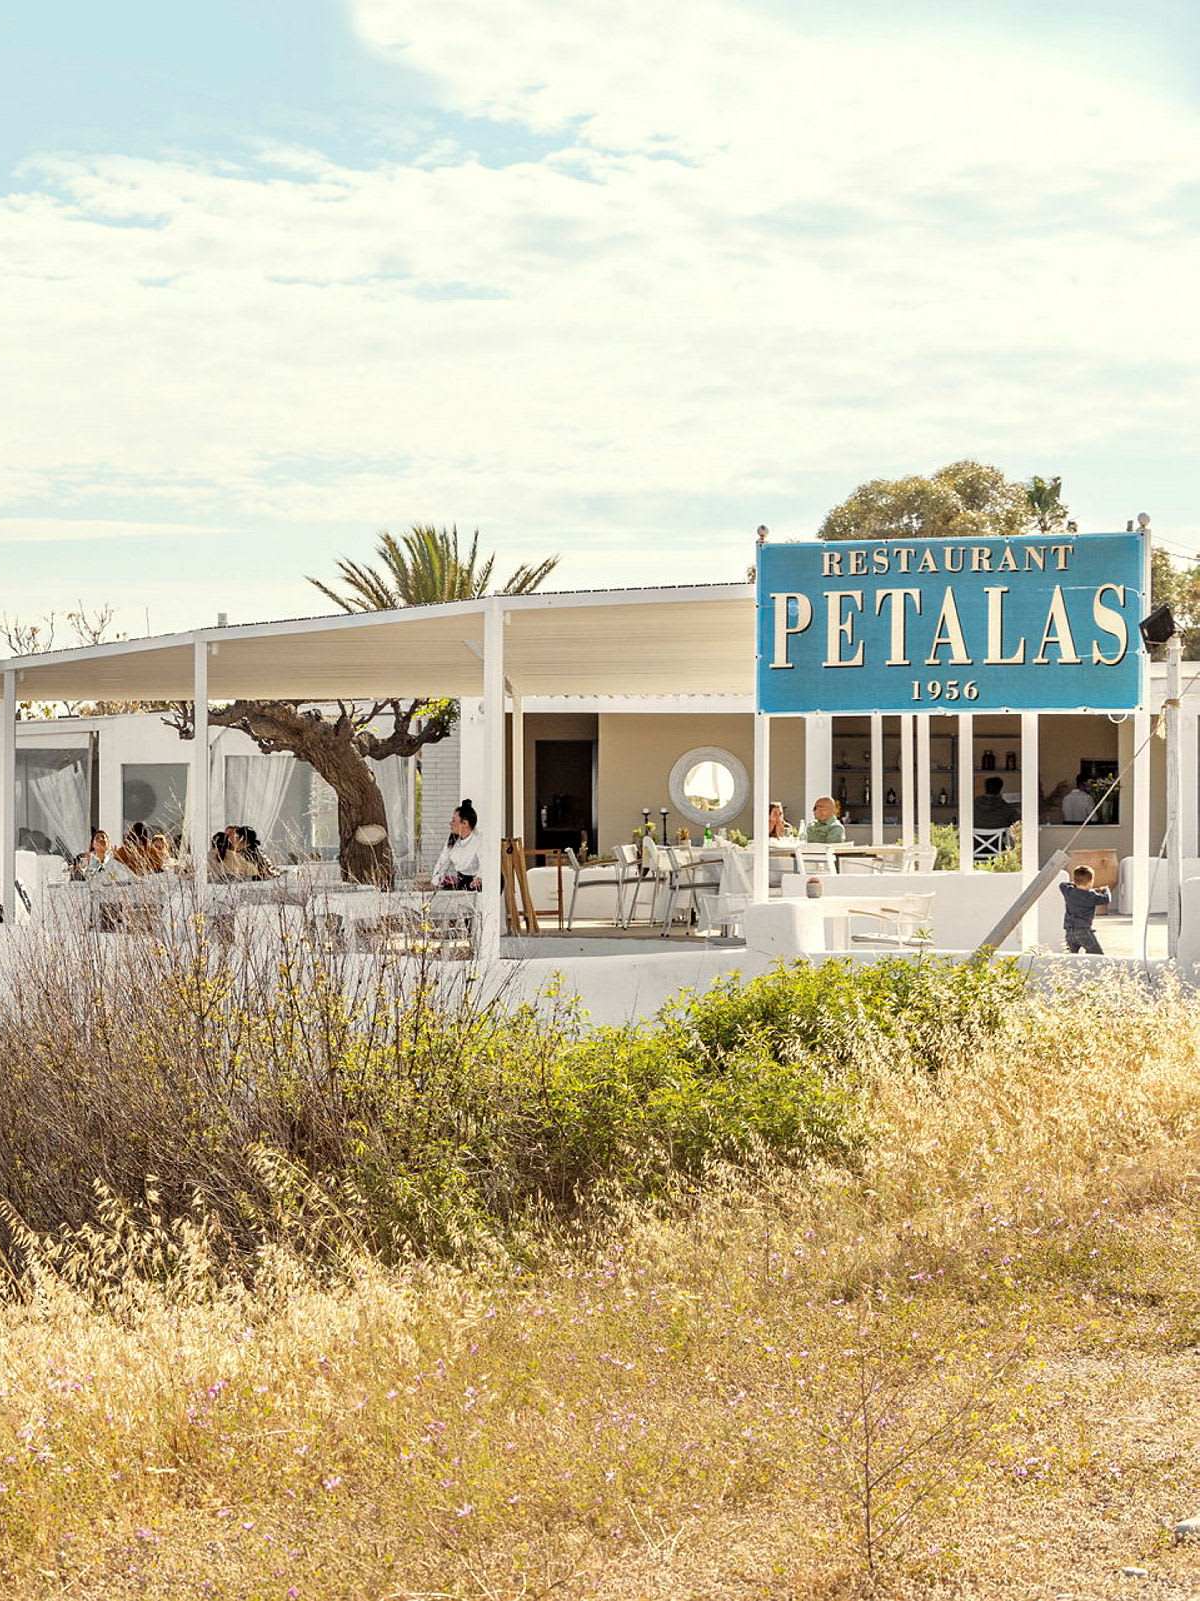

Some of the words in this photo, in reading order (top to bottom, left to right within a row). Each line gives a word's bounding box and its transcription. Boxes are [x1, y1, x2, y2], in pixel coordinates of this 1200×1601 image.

[821, 545, 1074, 576] RESTAURANT
[769, 583, 1128, 669] PETALAS
[911, 680, 979, 701] 1956
